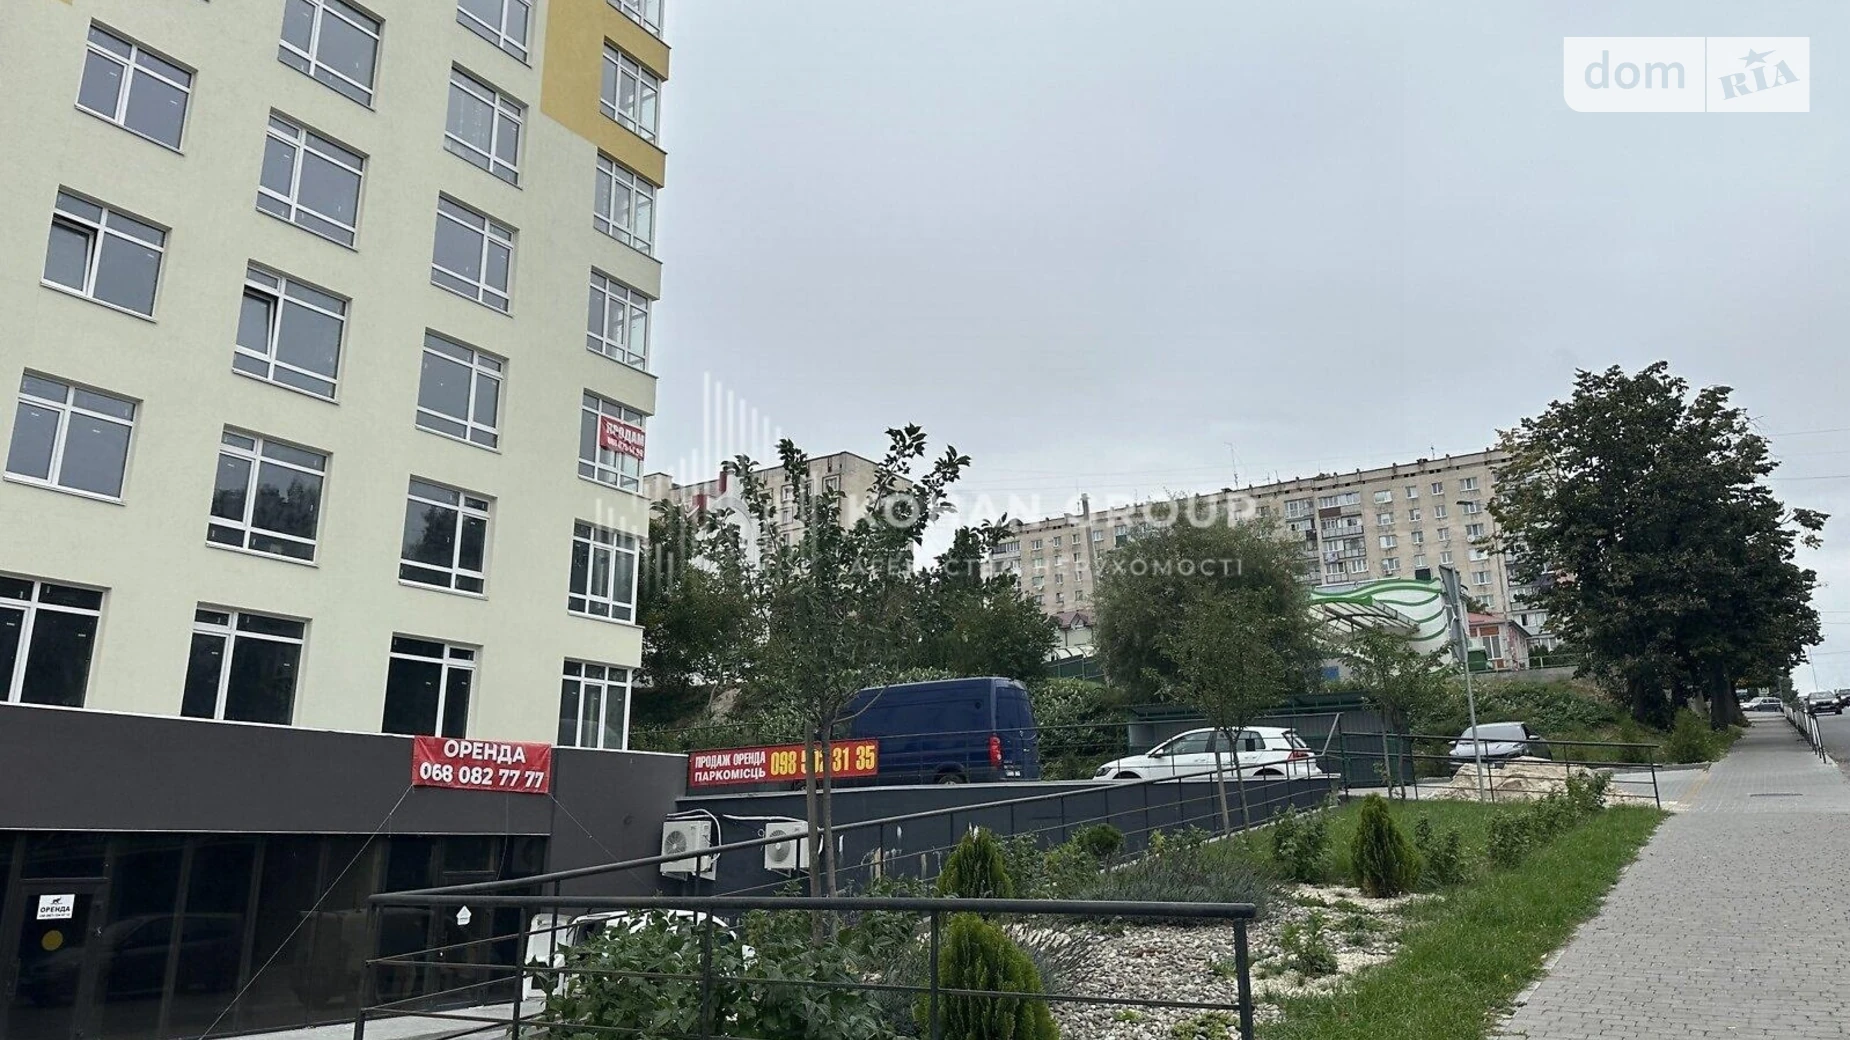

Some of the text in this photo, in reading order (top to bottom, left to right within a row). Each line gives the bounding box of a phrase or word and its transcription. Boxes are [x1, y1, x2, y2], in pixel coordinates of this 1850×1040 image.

[443, 740, 526, 765] ОРЕНДА
[695, 751, 766, 769] ПРОДАЖ ОРЕНДА
[770, 751, 797, 776] 098
[833, 747, 850, 772] 31
[856, 745, 876, 771] 35
[420, 761, 544, 788] 068 082 77 77
[694, 768, 766, 782] ПАРКОМІСЦЬ
